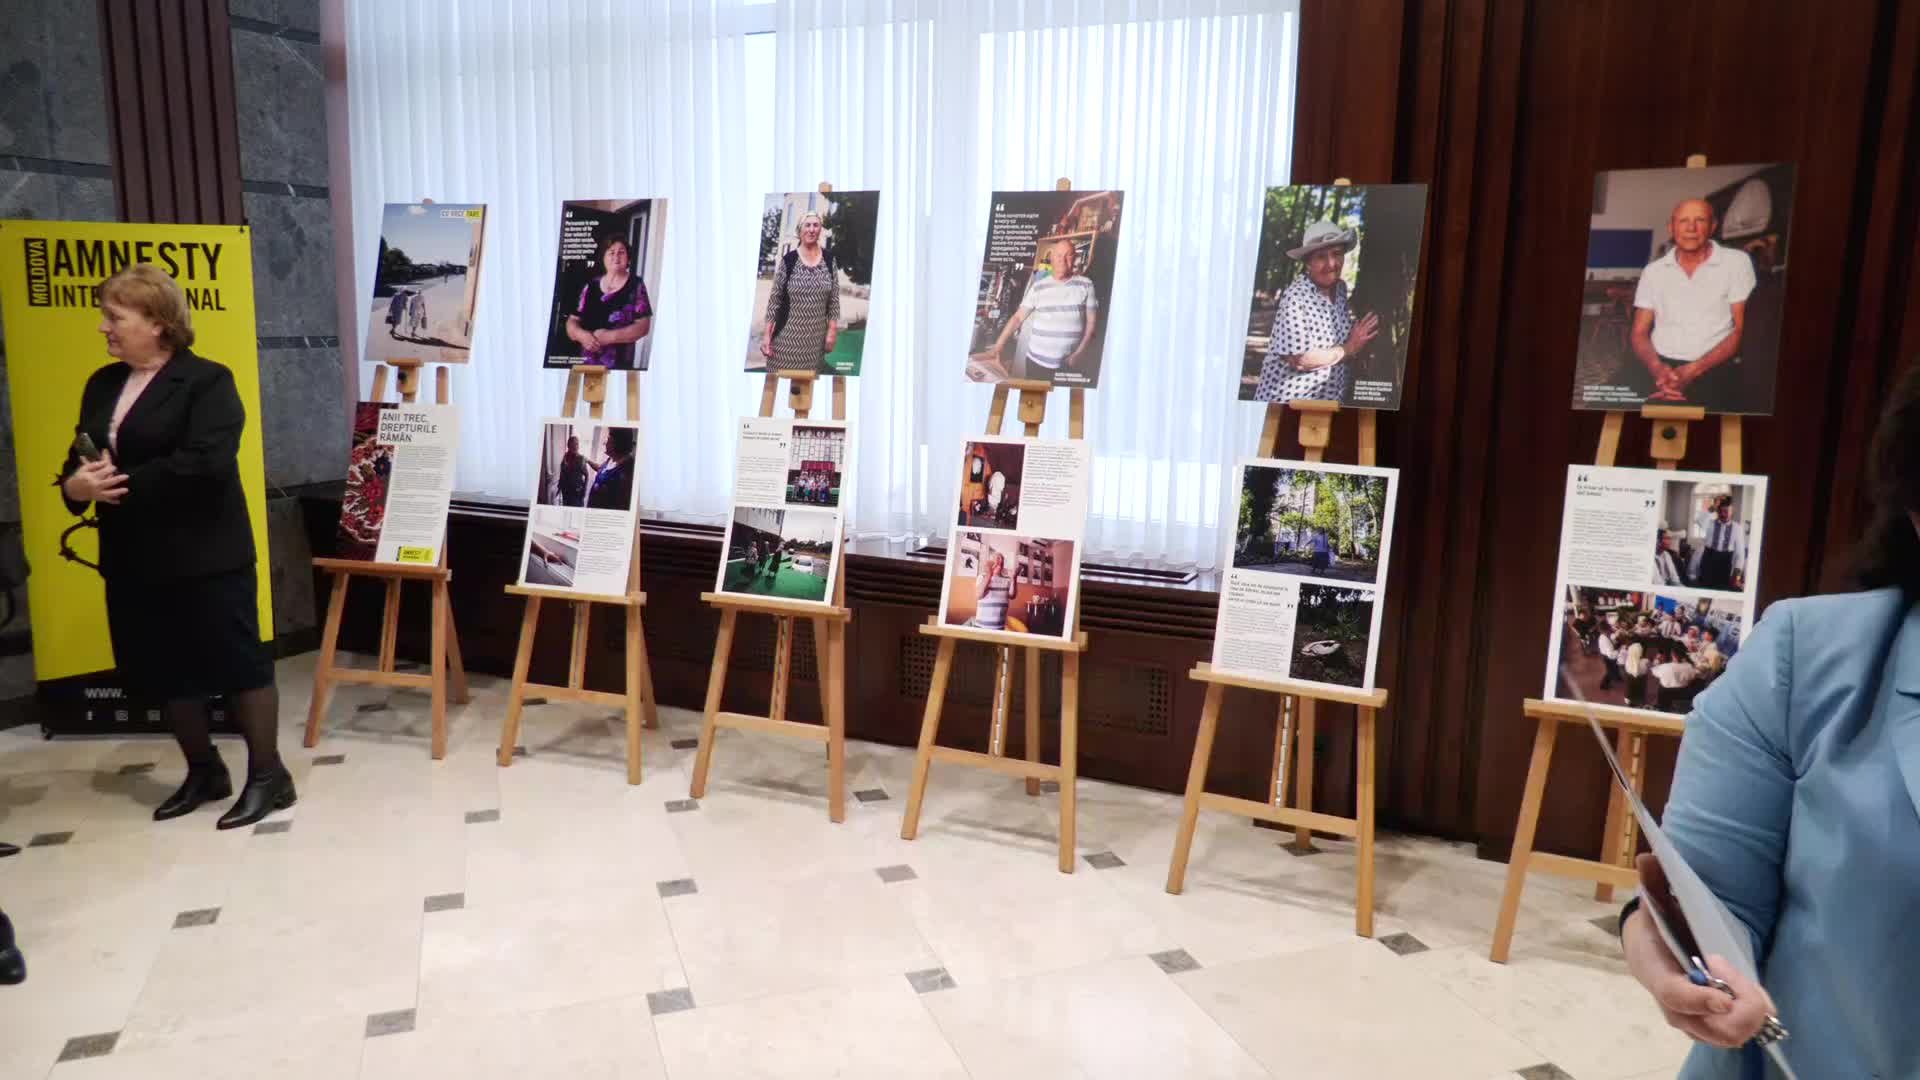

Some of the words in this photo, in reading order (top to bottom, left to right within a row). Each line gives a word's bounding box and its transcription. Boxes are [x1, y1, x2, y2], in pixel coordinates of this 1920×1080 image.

[53, 239, 223, 280] AMNESTY
[29, 240, 49, 305] MOLDOVA
[380, 423, 438, 433] DREPTURILE
[382, 413, 400, 421] ANII
